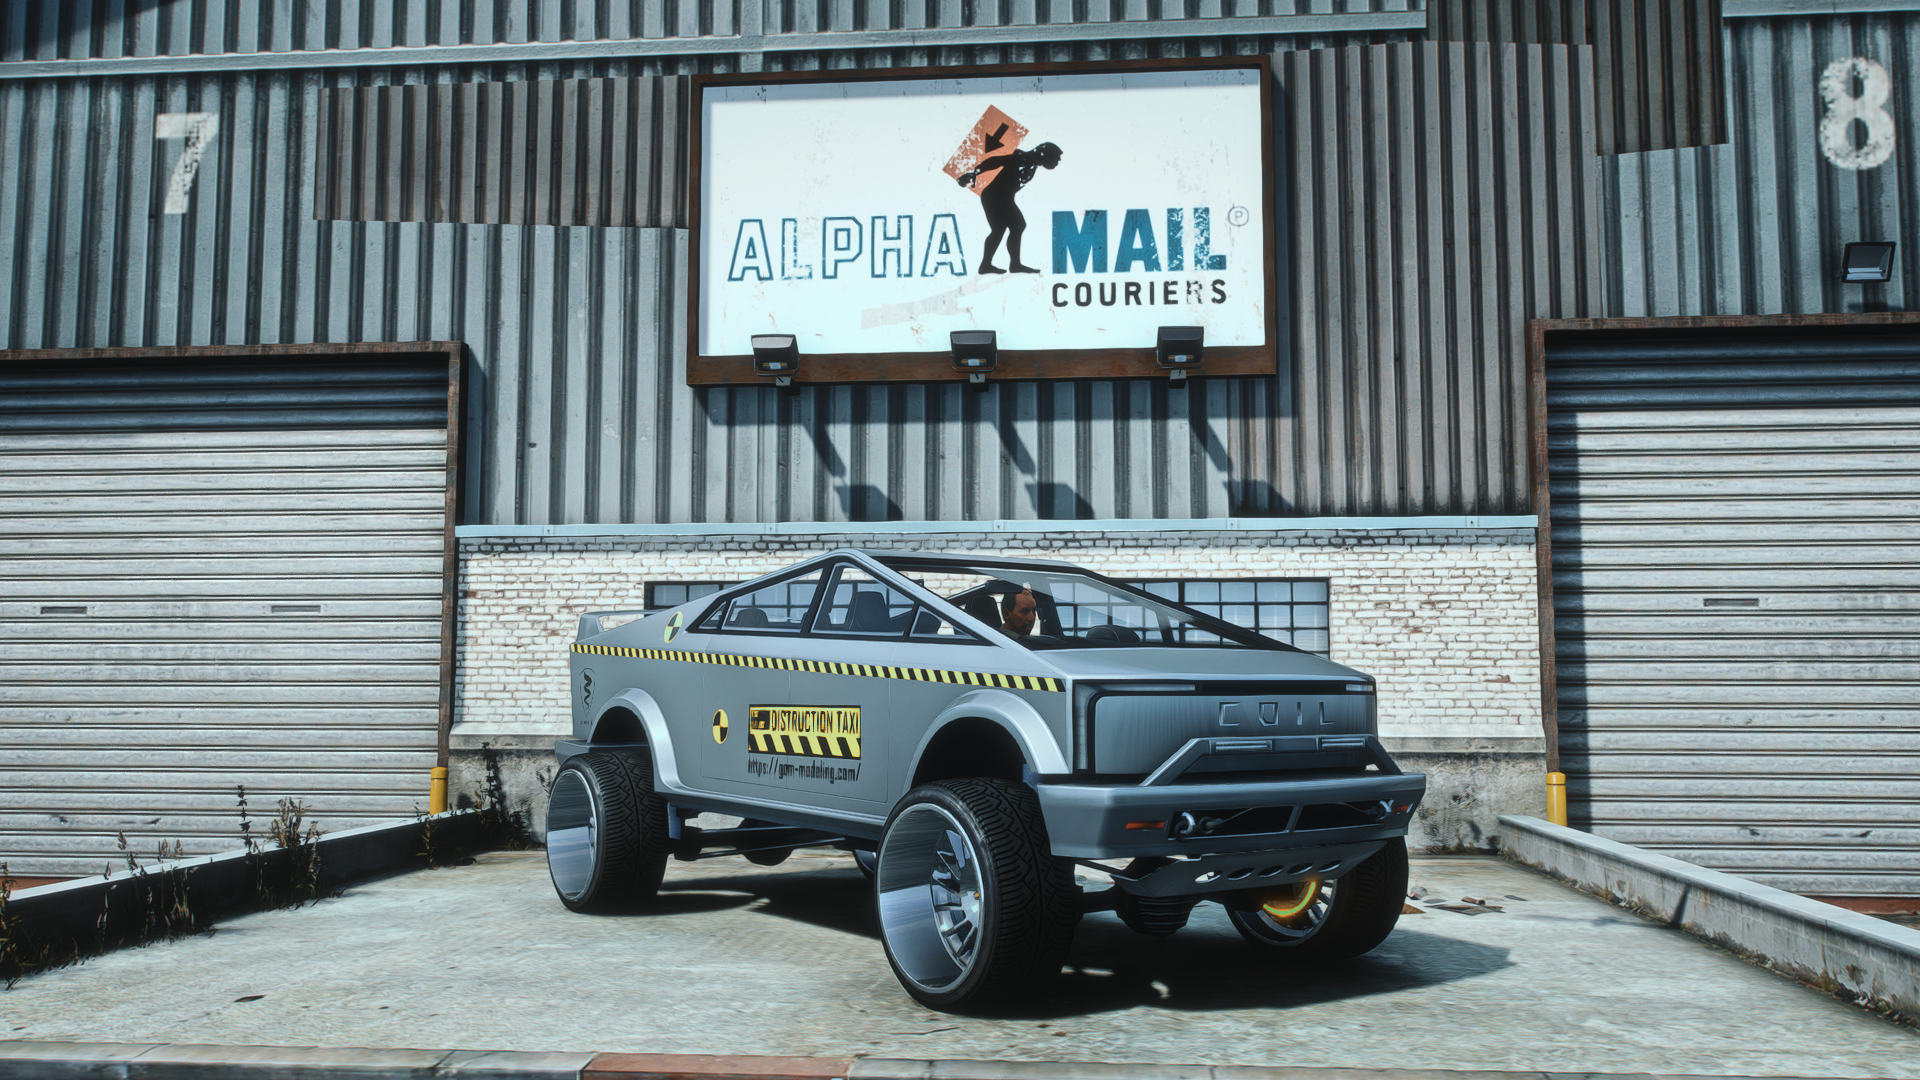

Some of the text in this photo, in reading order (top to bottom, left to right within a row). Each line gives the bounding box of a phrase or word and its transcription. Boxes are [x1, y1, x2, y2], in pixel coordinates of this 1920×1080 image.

[1819, 56, 1895, 170] 8
[156, 112, 218, 214] 7
[727, 213, 968, 282] ALPHA
[1052, 207, 1227, 274] MAIL
[1052, 279, 1227, 307] COURIERS
[771, 709, 859, 734] DISTRUCTION TAXI
[1218, 701, 1335, 727] COIL
